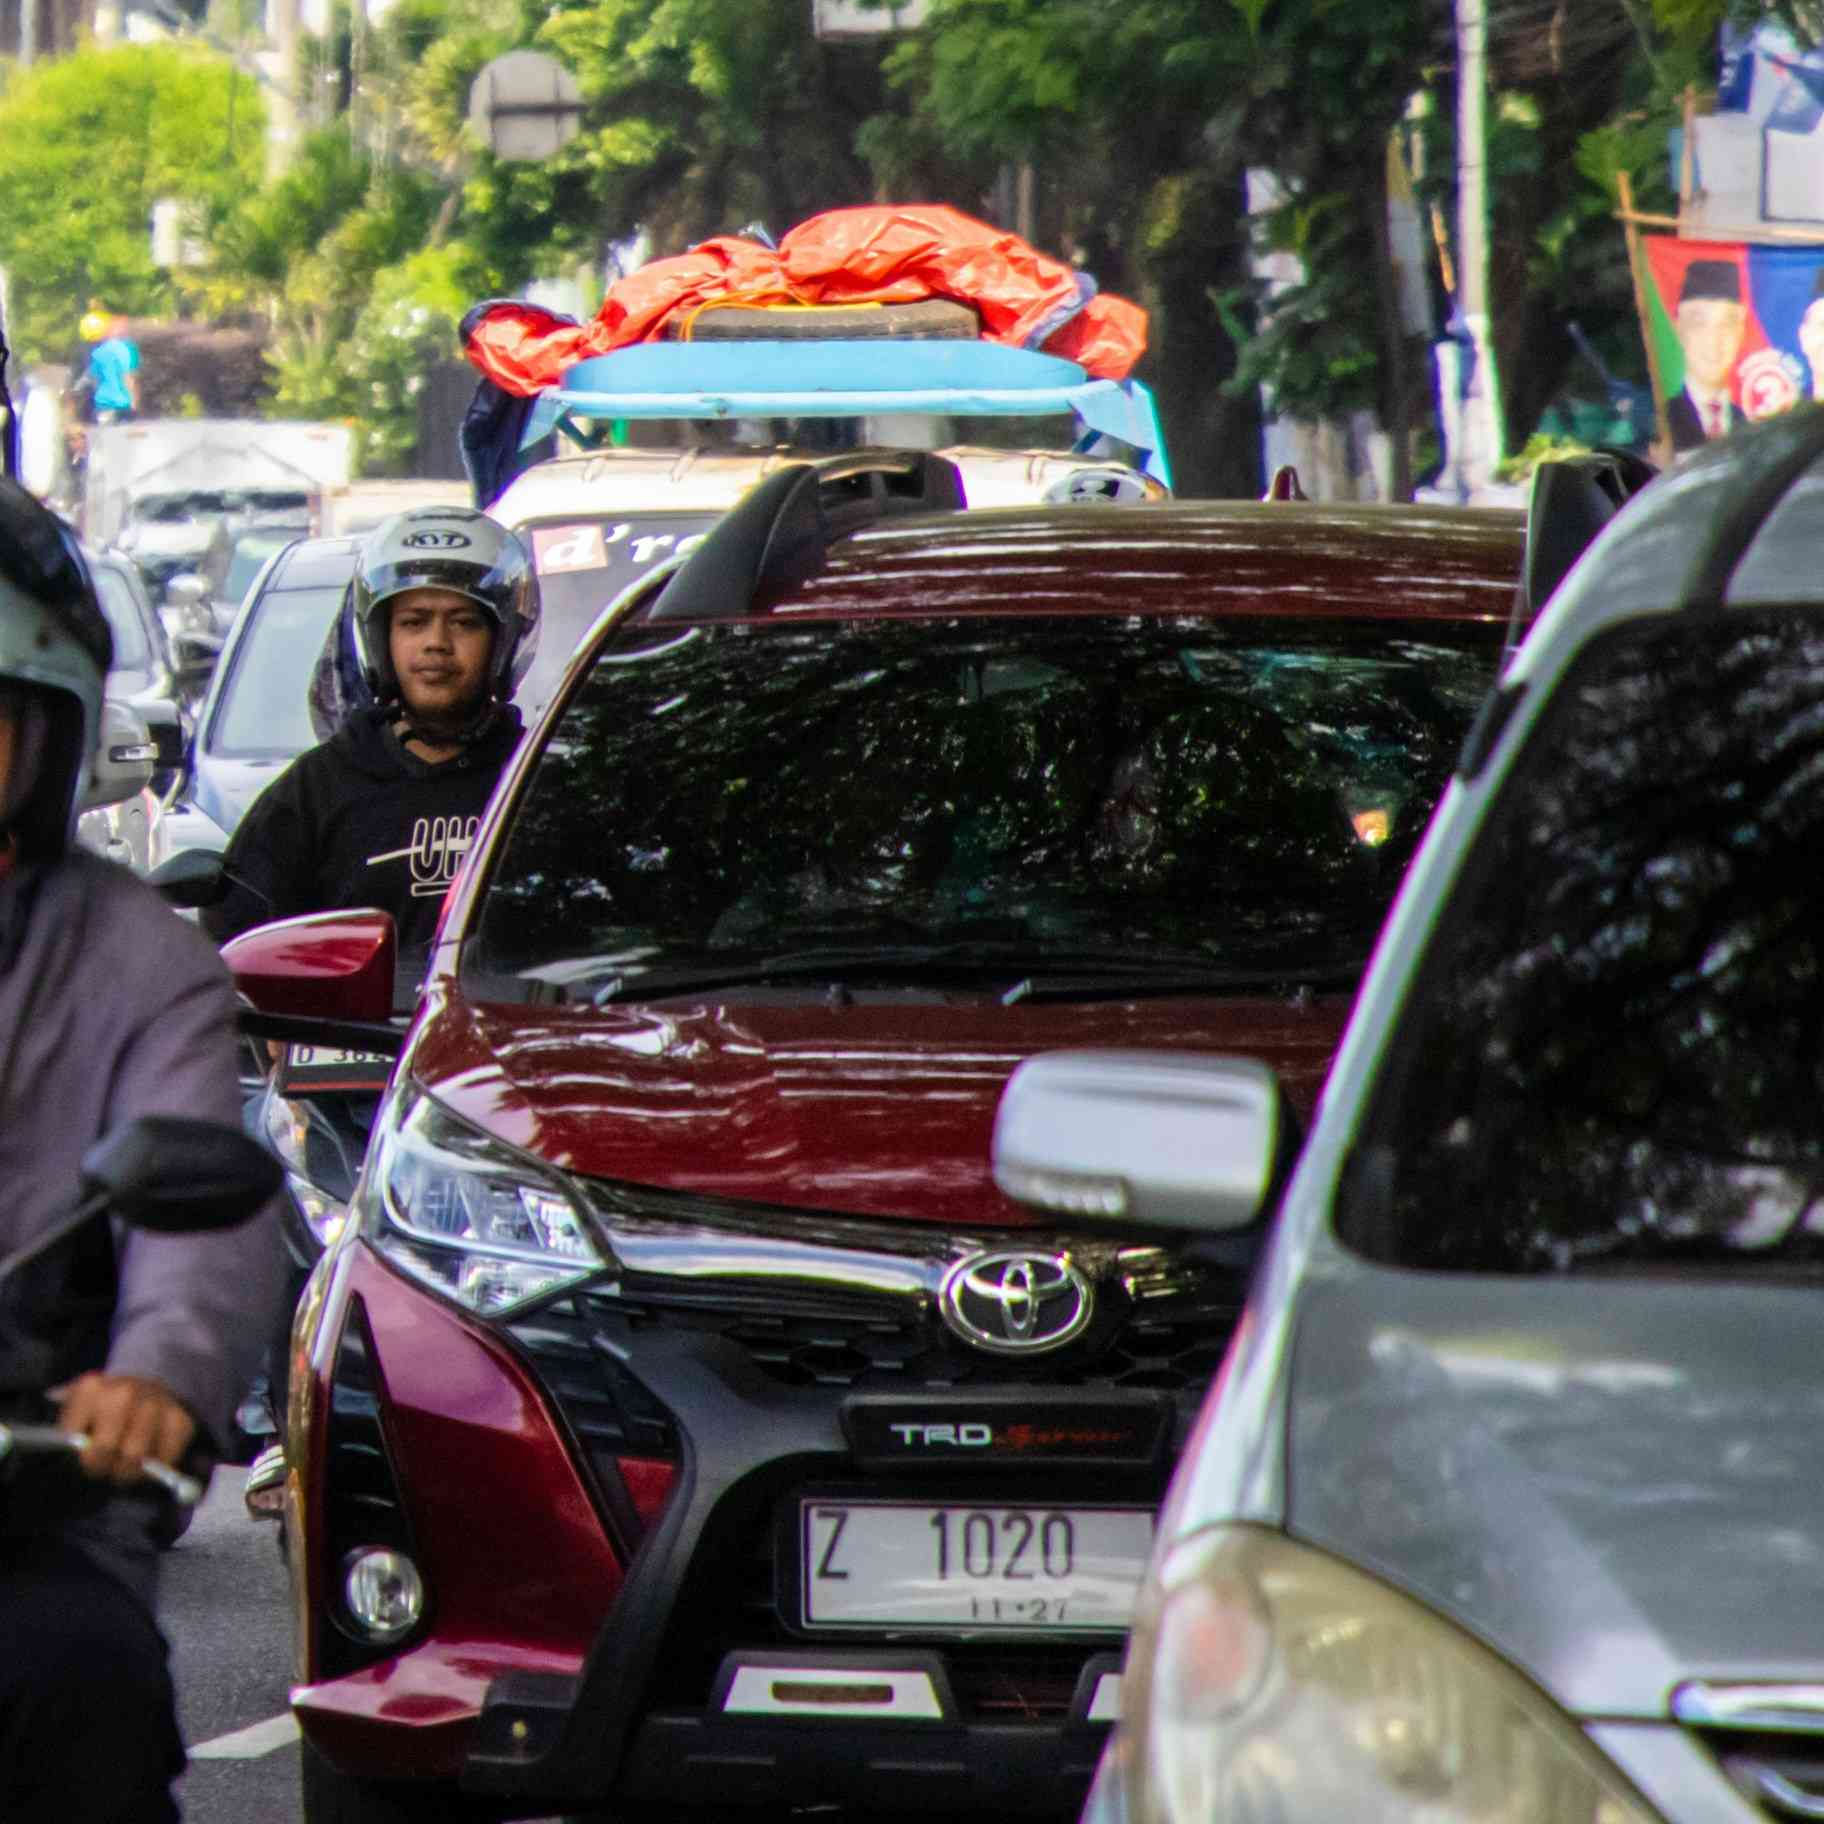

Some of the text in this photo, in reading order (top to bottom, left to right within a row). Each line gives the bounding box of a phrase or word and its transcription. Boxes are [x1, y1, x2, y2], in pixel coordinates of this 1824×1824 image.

[890, 1424, 992, 1446] TRD
[816, 1509, 1075, 1580] Z 1020
